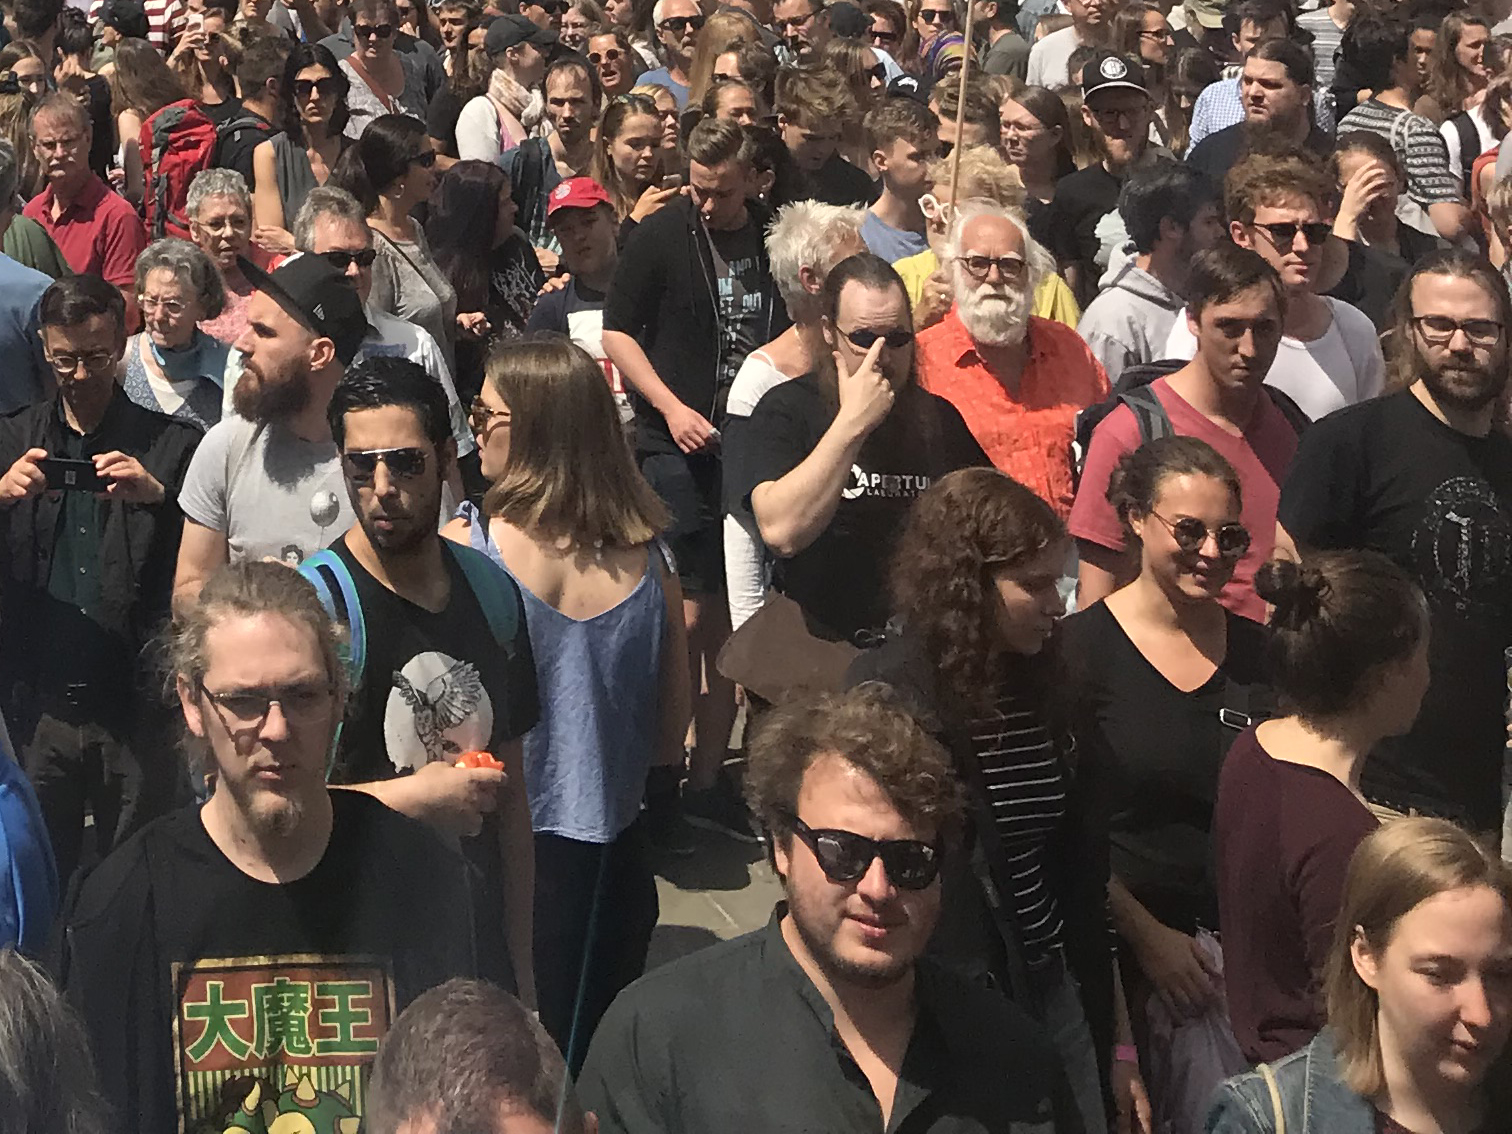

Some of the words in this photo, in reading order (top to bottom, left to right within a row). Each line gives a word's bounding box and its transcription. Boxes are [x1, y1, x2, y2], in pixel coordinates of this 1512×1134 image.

[866, 487, 917, 499] LABORAT
[183, 976, 380, 1064] 大魔王
